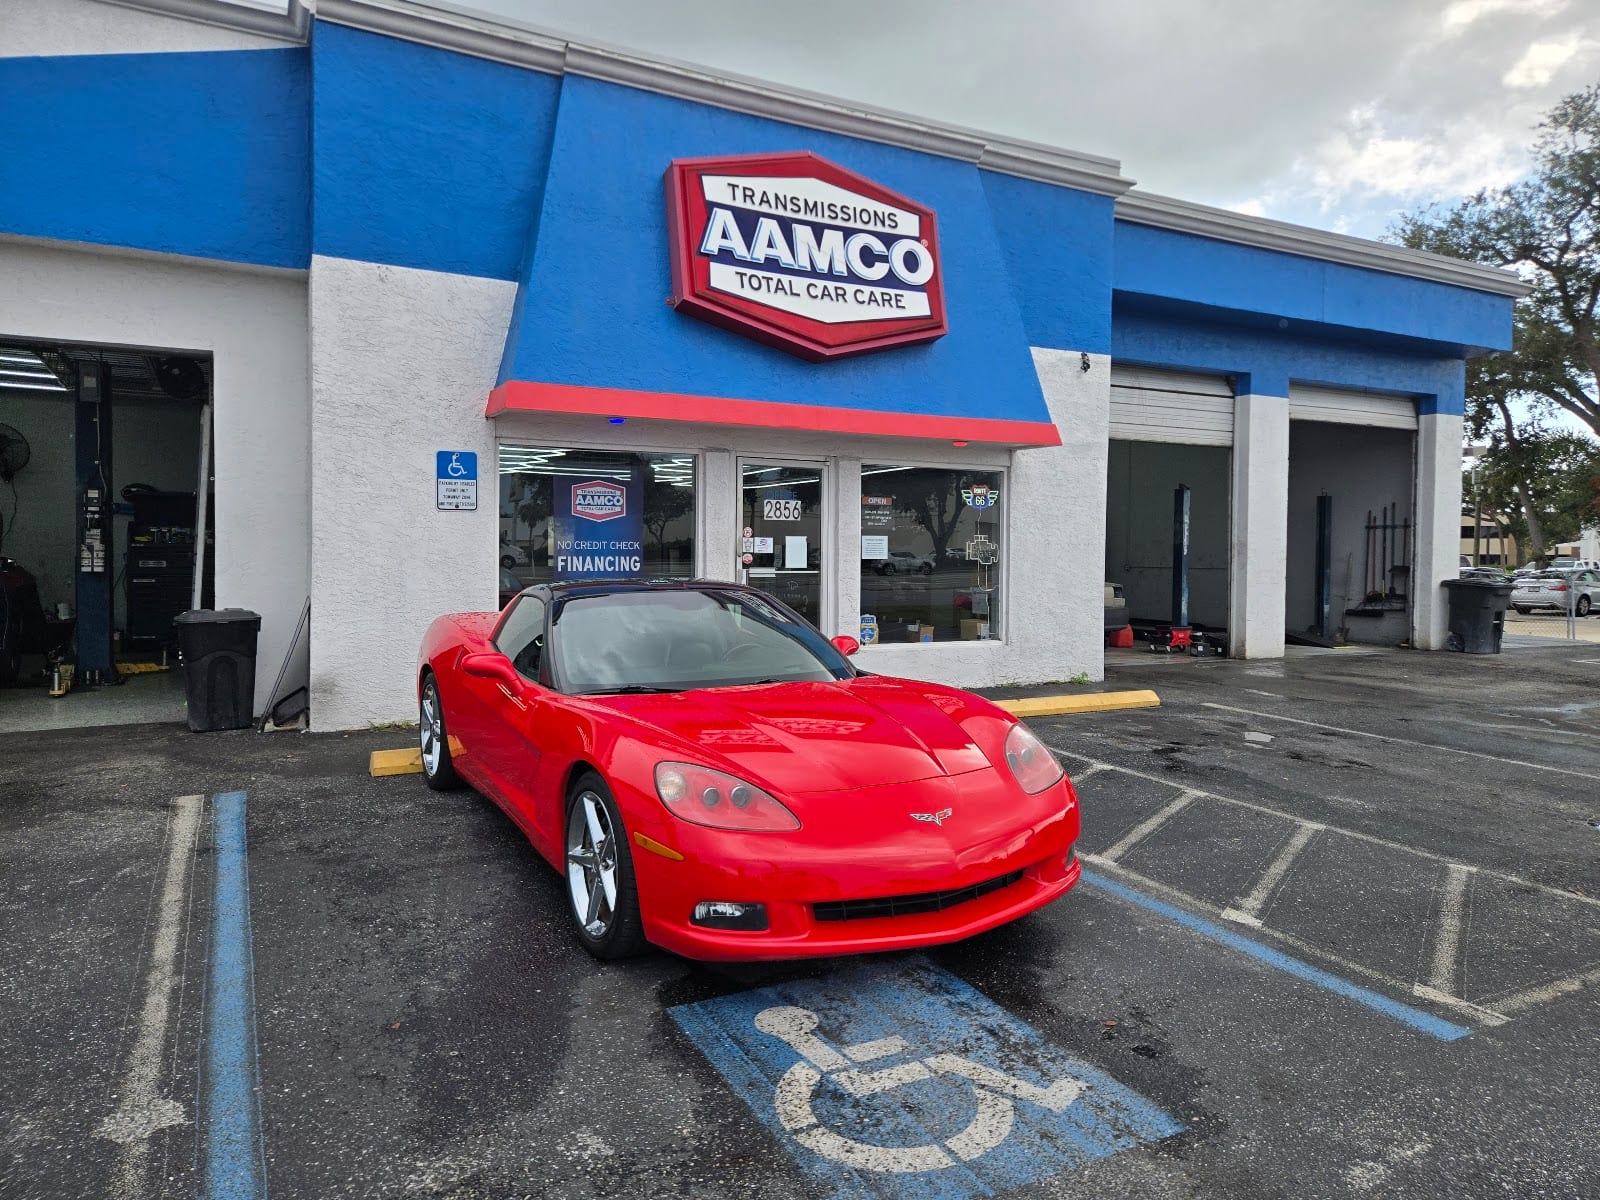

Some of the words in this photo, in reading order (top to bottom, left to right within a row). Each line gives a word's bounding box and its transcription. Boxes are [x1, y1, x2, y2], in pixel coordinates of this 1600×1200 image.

[727, 182, 899, 229] TRANSMISSIONS
[700, 207, 934, 286] AAMCO
[735, 271, 801, 297] TOTAL
[806, 283, 848, 303] CAR
[853, 289, 906, 309] CARE
[575, 494, 623, 506] AAMCO
[868, 497, 886, 505] OPEN
[975, 496, 985, 506] 66
[765, 500, 801, 520] 2856
[557, 540, 572, 550] NO
[574, 540, 608, 550] CREDIT
[610, 541, 640, 551] CHECK
[557, 555, 641, 572] FINANCING
